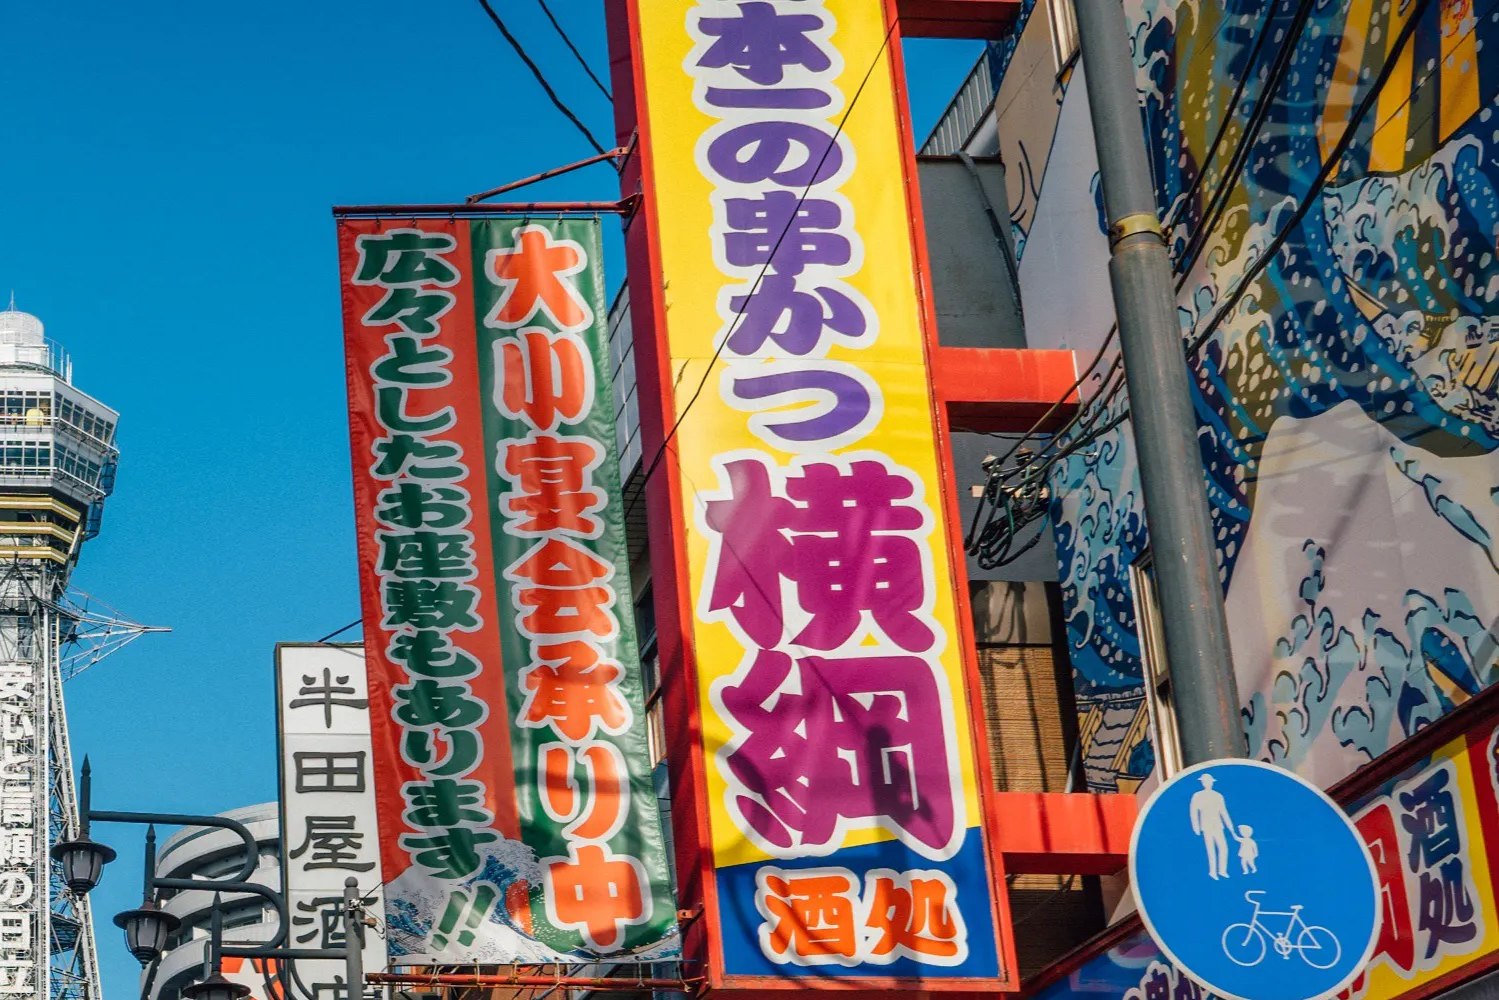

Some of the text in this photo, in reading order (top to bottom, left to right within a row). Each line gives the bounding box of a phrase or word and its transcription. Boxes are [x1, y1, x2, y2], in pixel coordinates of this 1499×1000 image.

[696, 450, 966, 862] 横綱
[757, 867, 966, 968] 酒処
[1394, 757, 1486, 968] 酒処
